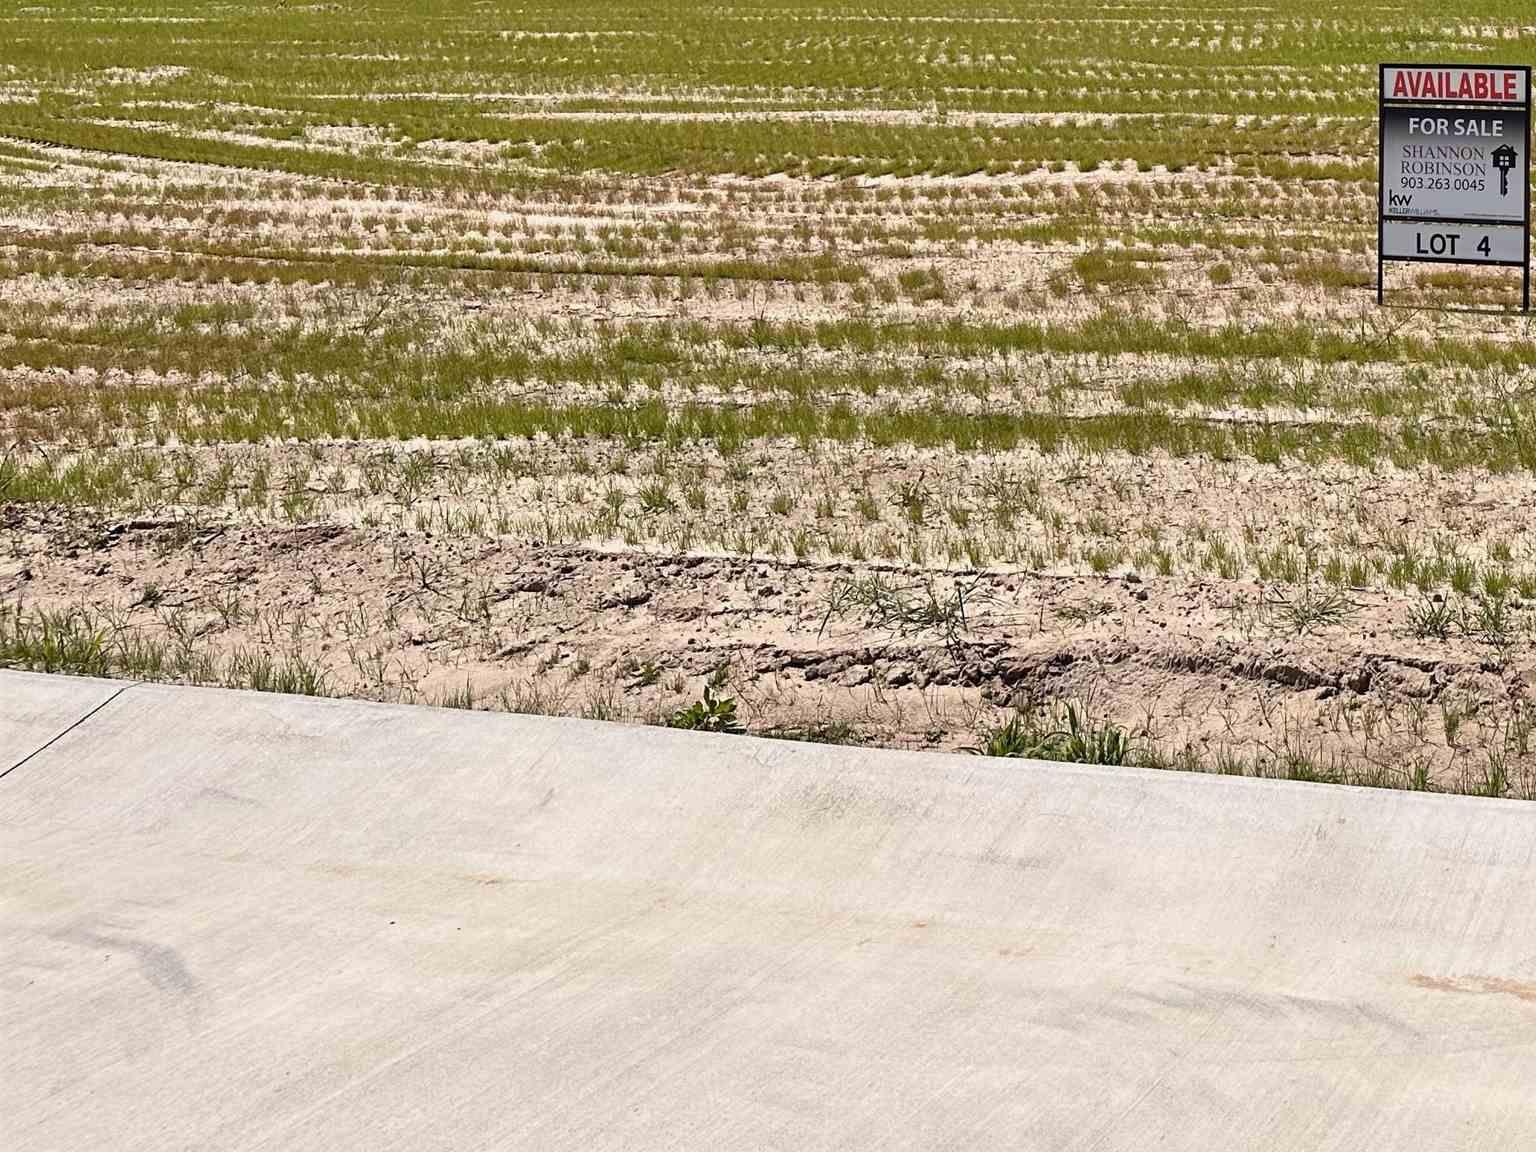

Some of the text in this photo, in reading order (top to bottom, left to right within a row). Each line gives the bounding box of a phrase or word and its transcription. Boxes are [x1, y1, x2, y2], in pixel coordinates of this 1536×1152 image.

[1392, 71, 1517, 100] AVAILABLE
[1408, 117, 1504, 137] FOR SALE
[1402, 144, 1485, 160] SHANNON
[1400, 160, 1487, 176] ROBINSON
[1388, 189, 1413, 207] kw
[1416, 232, 1492, 257] LOT 4
